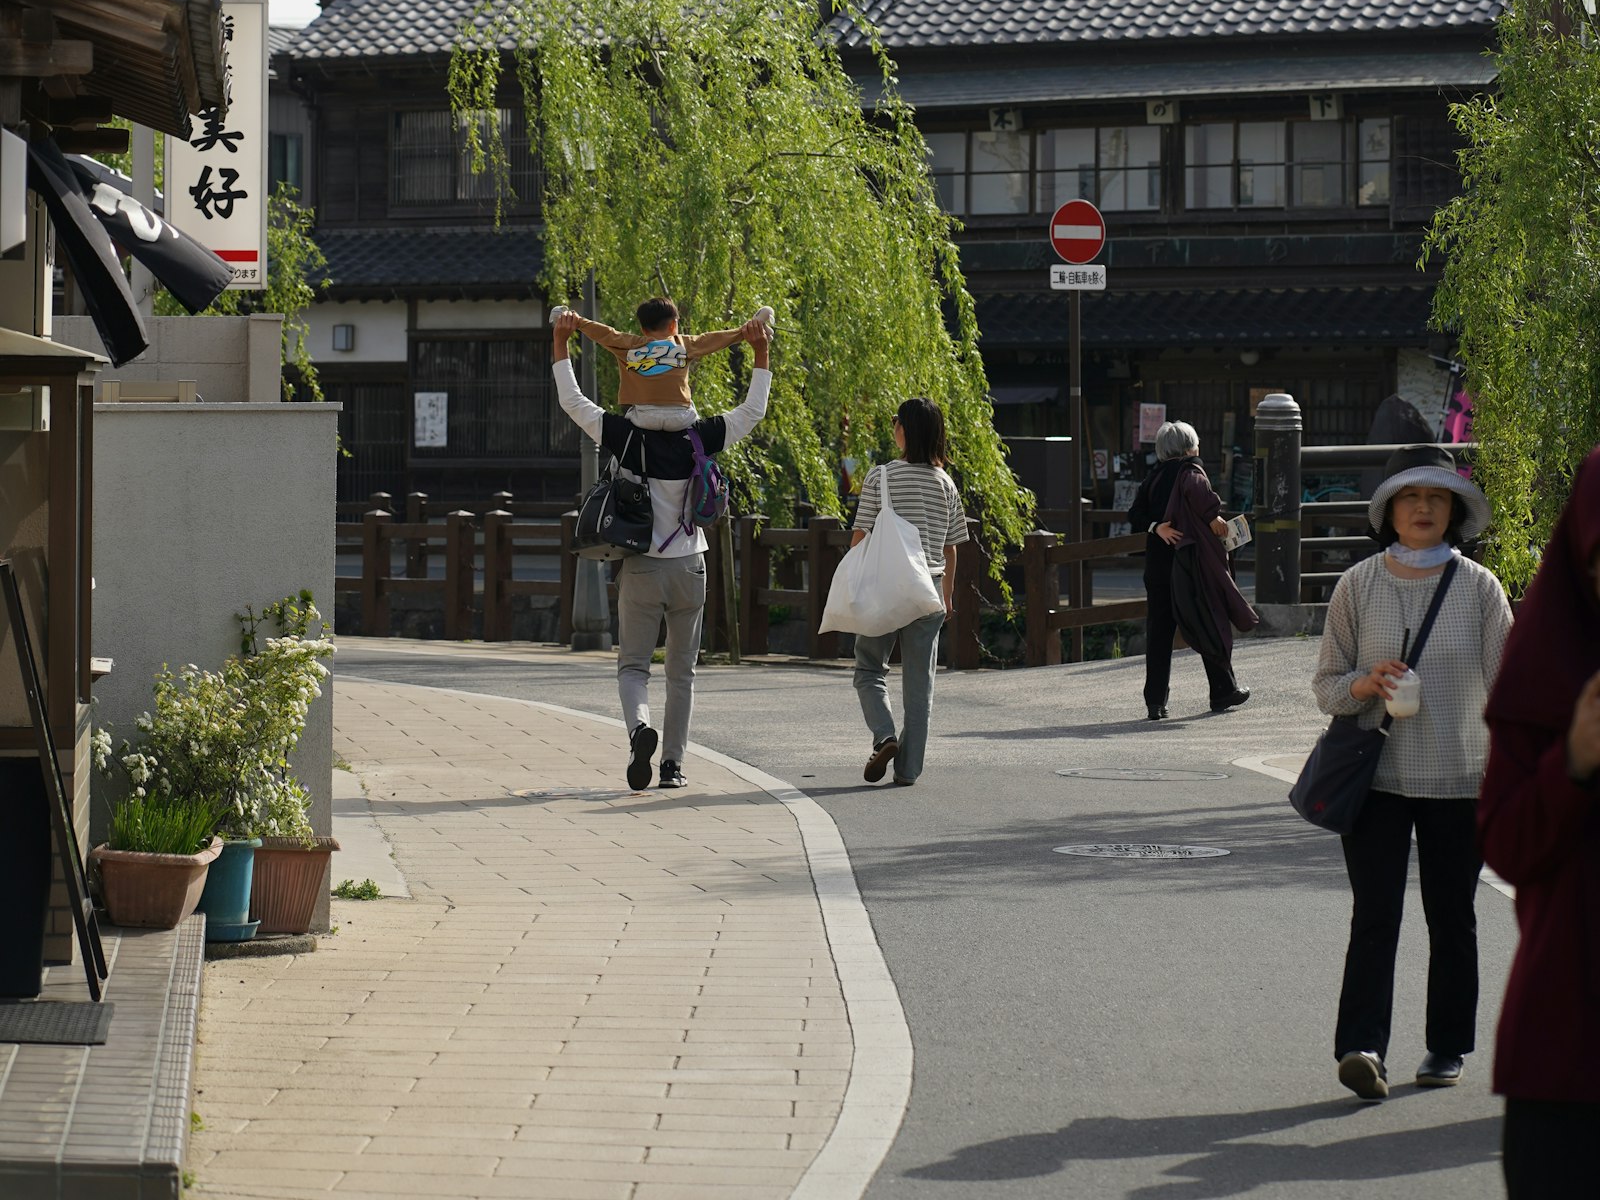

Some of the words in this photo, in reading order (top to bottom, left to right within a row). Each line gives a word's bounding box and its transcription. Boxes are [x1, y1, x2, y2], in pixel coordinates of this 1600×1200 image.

[189, 52, 248, 220] 美好
[232, 268, 258, 279] ります
[1053, 270, 1105, 285] 二輪・自転車を除く
